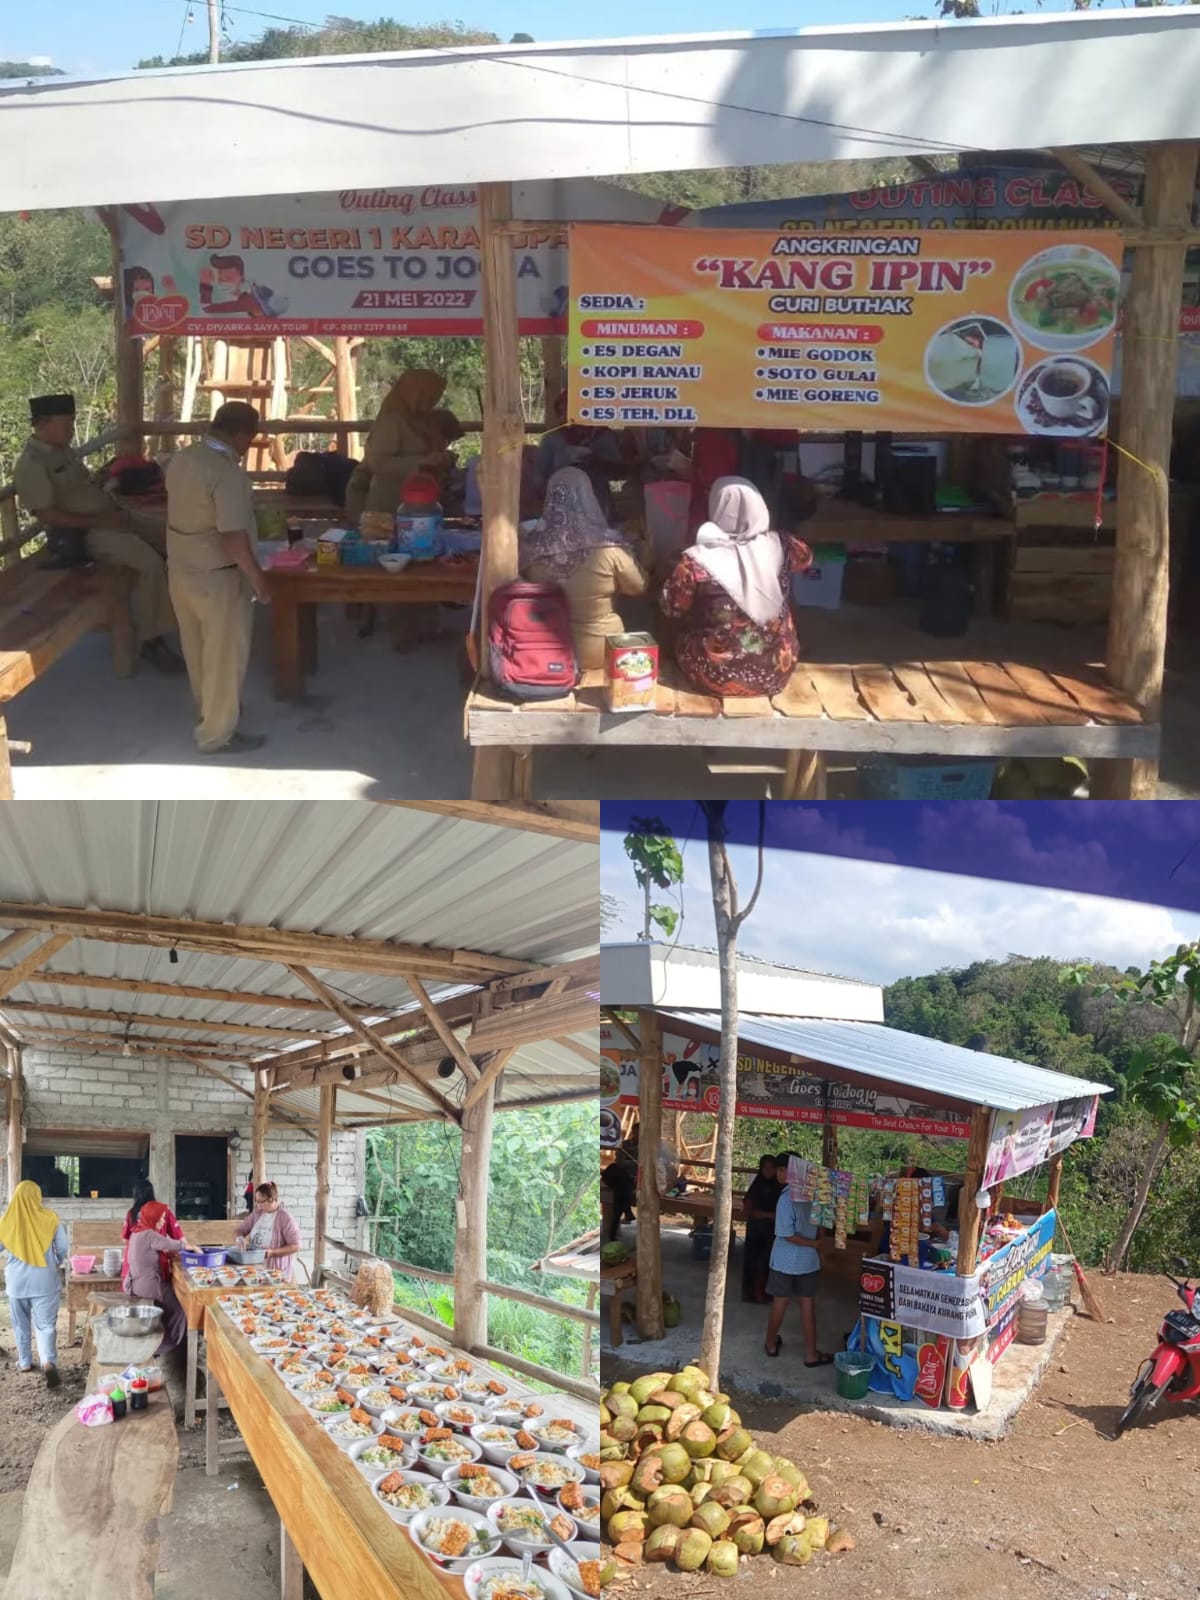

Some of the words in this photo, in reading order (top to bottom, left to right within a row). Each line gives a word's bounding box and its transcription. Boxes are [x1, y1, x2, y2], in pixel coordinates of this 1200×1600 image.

[421, 187, 480, 209] Class
[184, 225, 232, 250] SD
[239, 226, 361, 250] NEGERI
[367, 227, 383, 250] 1
[773, 237, 920, 256] ANGKRINGAN
[287, 254, 375, 279] GOES
[383, 254, 427, 279] TO
[435, 255, 541, 279] JOA
[362, 293, 379, 306] 21
[385, 293, 418, 306] MEI
[423, 292, 466, 306] 2022
[579, 295, 634, 310] SEDIA
[768, 296, 821, 314] CURI
[824, 297, 912, 315] BUTHAK
[596, 322, 678, 336] MINUMAN
[771, 326, 859, 341] MAKANAN
[594, 345, 616, 358] ES
[621, 345, 682, 359] DEGAN
[768, 346, 802, 361] MIE
[806, 348, 874, 363] GODOK
[593, 365, 638, 379] KOPI
[642, 366, 702, 380] RANAU
[767, 367, 818, 381] SOTO
[822, 368, 878, 383] GULAI
[593, 387, 616, 400] ES
[620, 386, 678, 401] JERUK
[766, 388, 799, 402] MIE
[803, 388, 880, 404] GORENG
[593, 407, 616, 421] ES
[664, 408, 697, 421] DLL
[871, 1117, 881, 1126] The
[921, 1122, 932, 1131] For
[951, 1125, 965, 1136] Trip
[899, 1283, 940, 1301] SELAMATKAN
[898, 1296, 913, 1308] DARI
